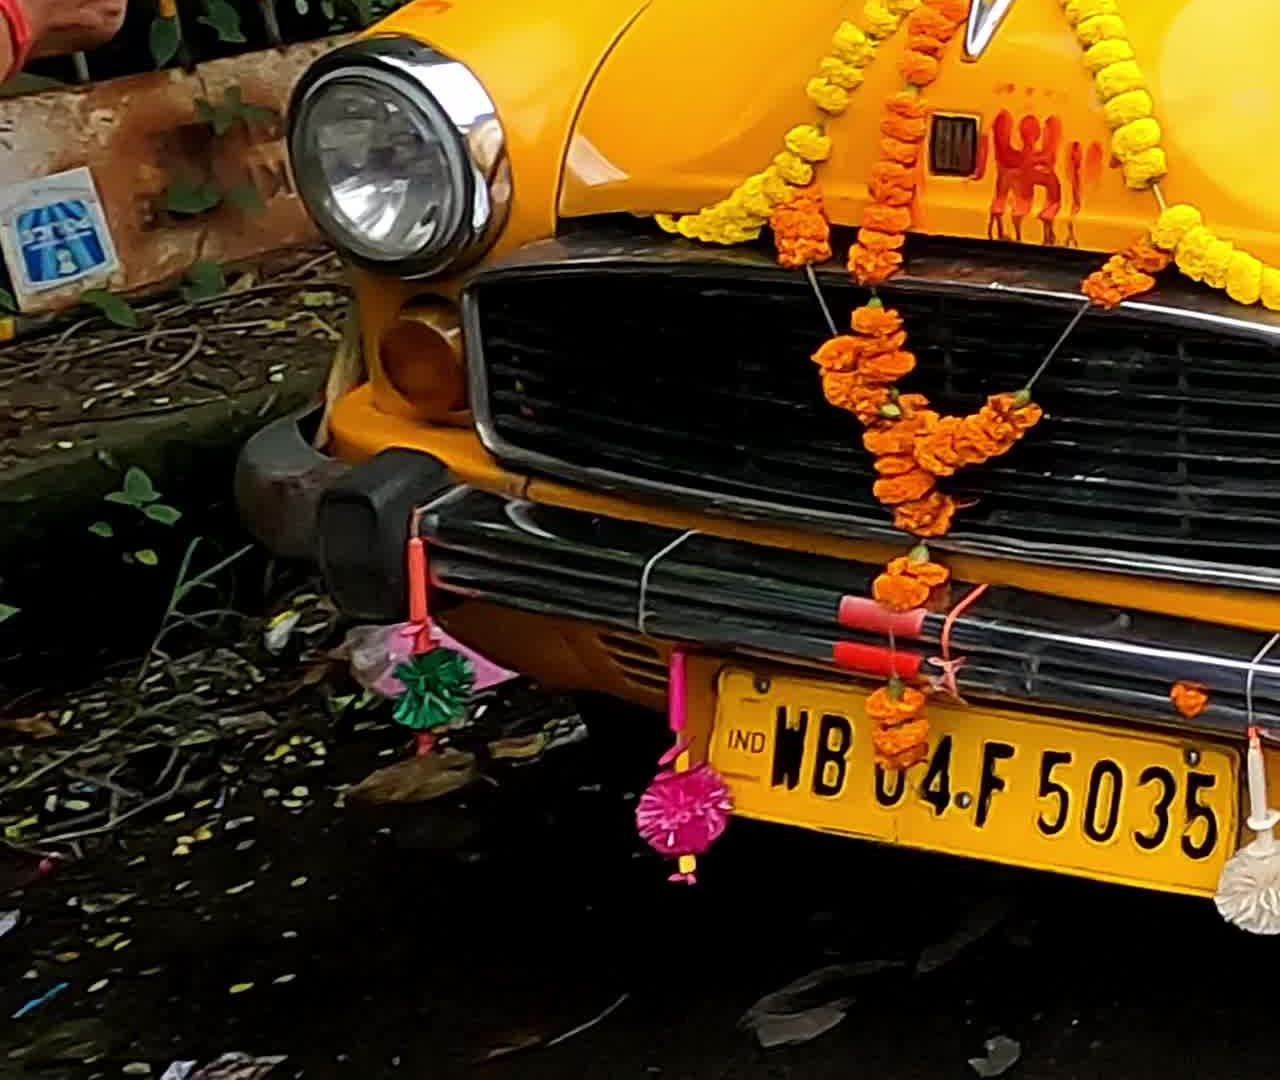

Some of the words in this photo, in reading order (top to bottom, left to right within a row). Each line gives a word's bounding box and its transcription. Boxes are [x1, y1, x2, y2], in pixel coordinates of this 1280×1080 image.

[728, 729, 766, 754] IND
[771, 706, 852, 797] WB
[1037, 750, 1217, 860] 5035
